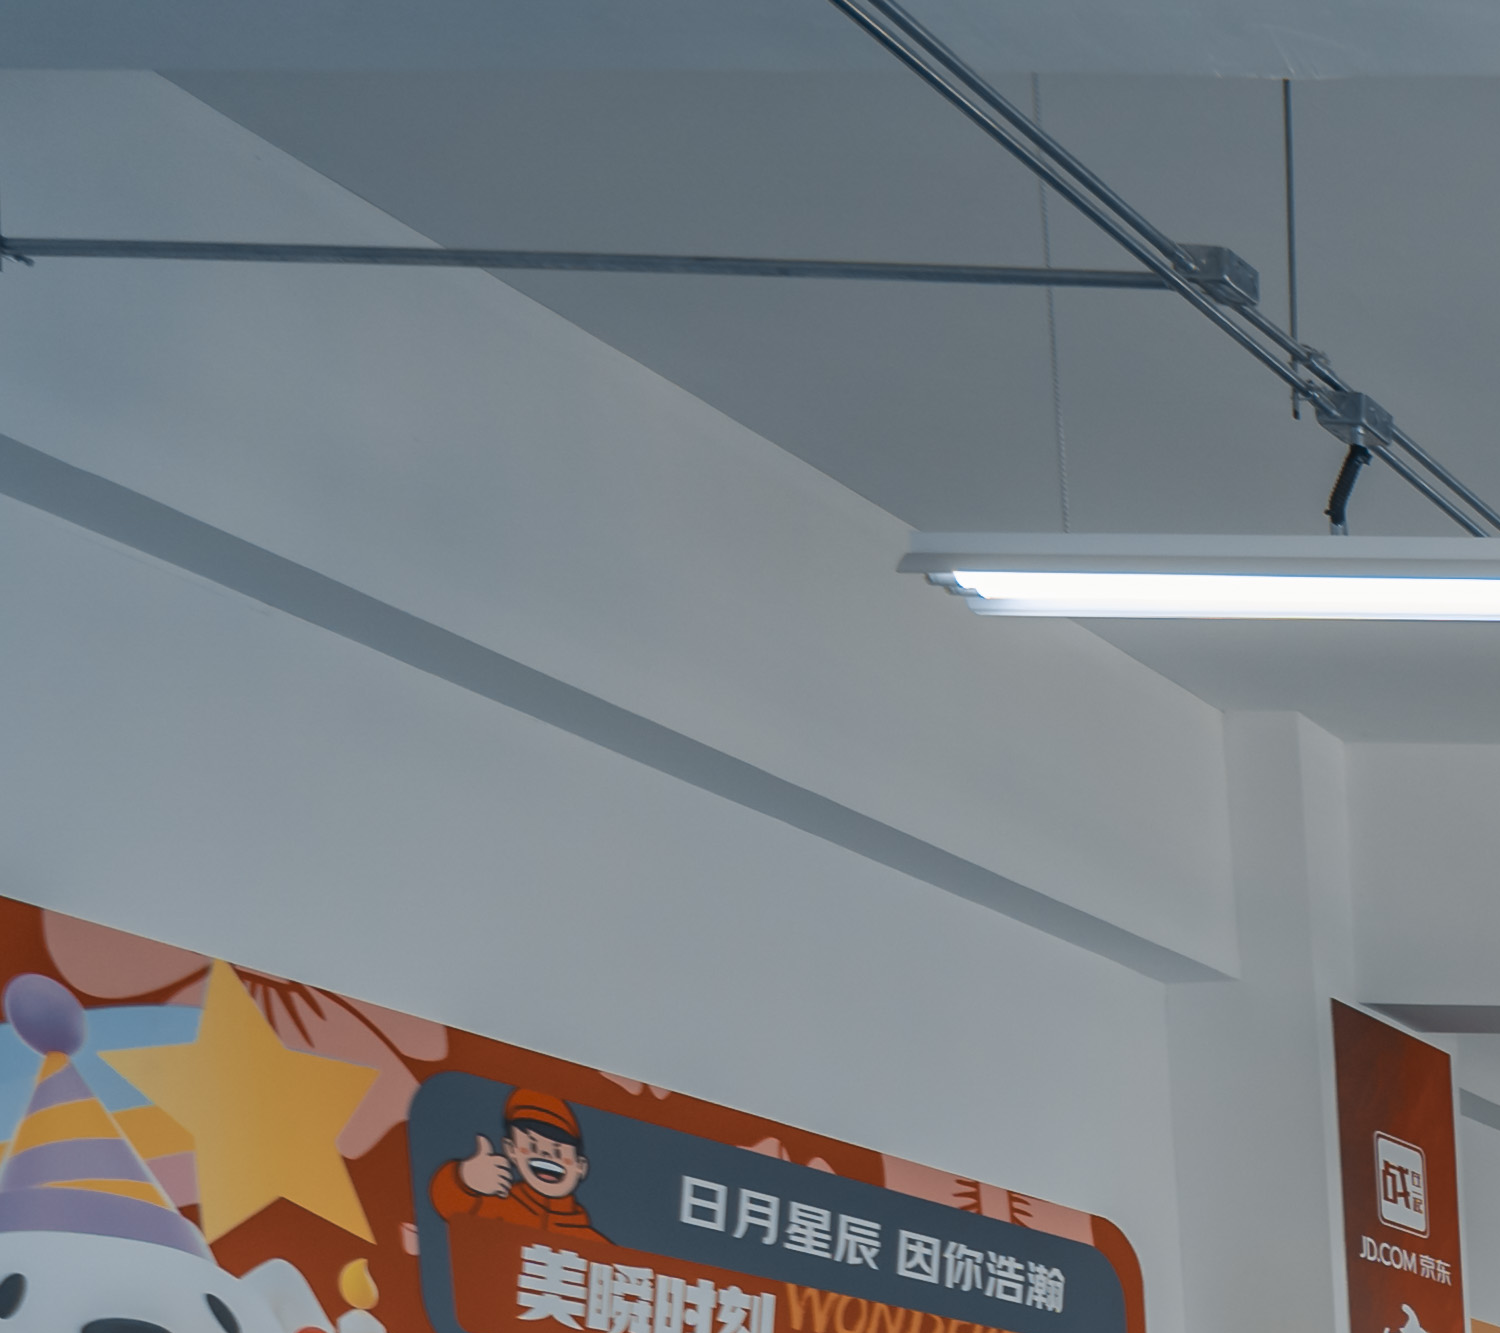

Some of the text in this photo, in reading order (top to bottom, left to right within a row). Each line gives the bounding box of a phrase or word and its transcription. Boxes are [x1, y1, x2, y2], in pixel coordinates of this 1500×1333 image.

[679, 1174, 1065, 1314] 日月星辰 因你浩瀚
[1360, 1235, 1452, 1287] JD.COM 京东
